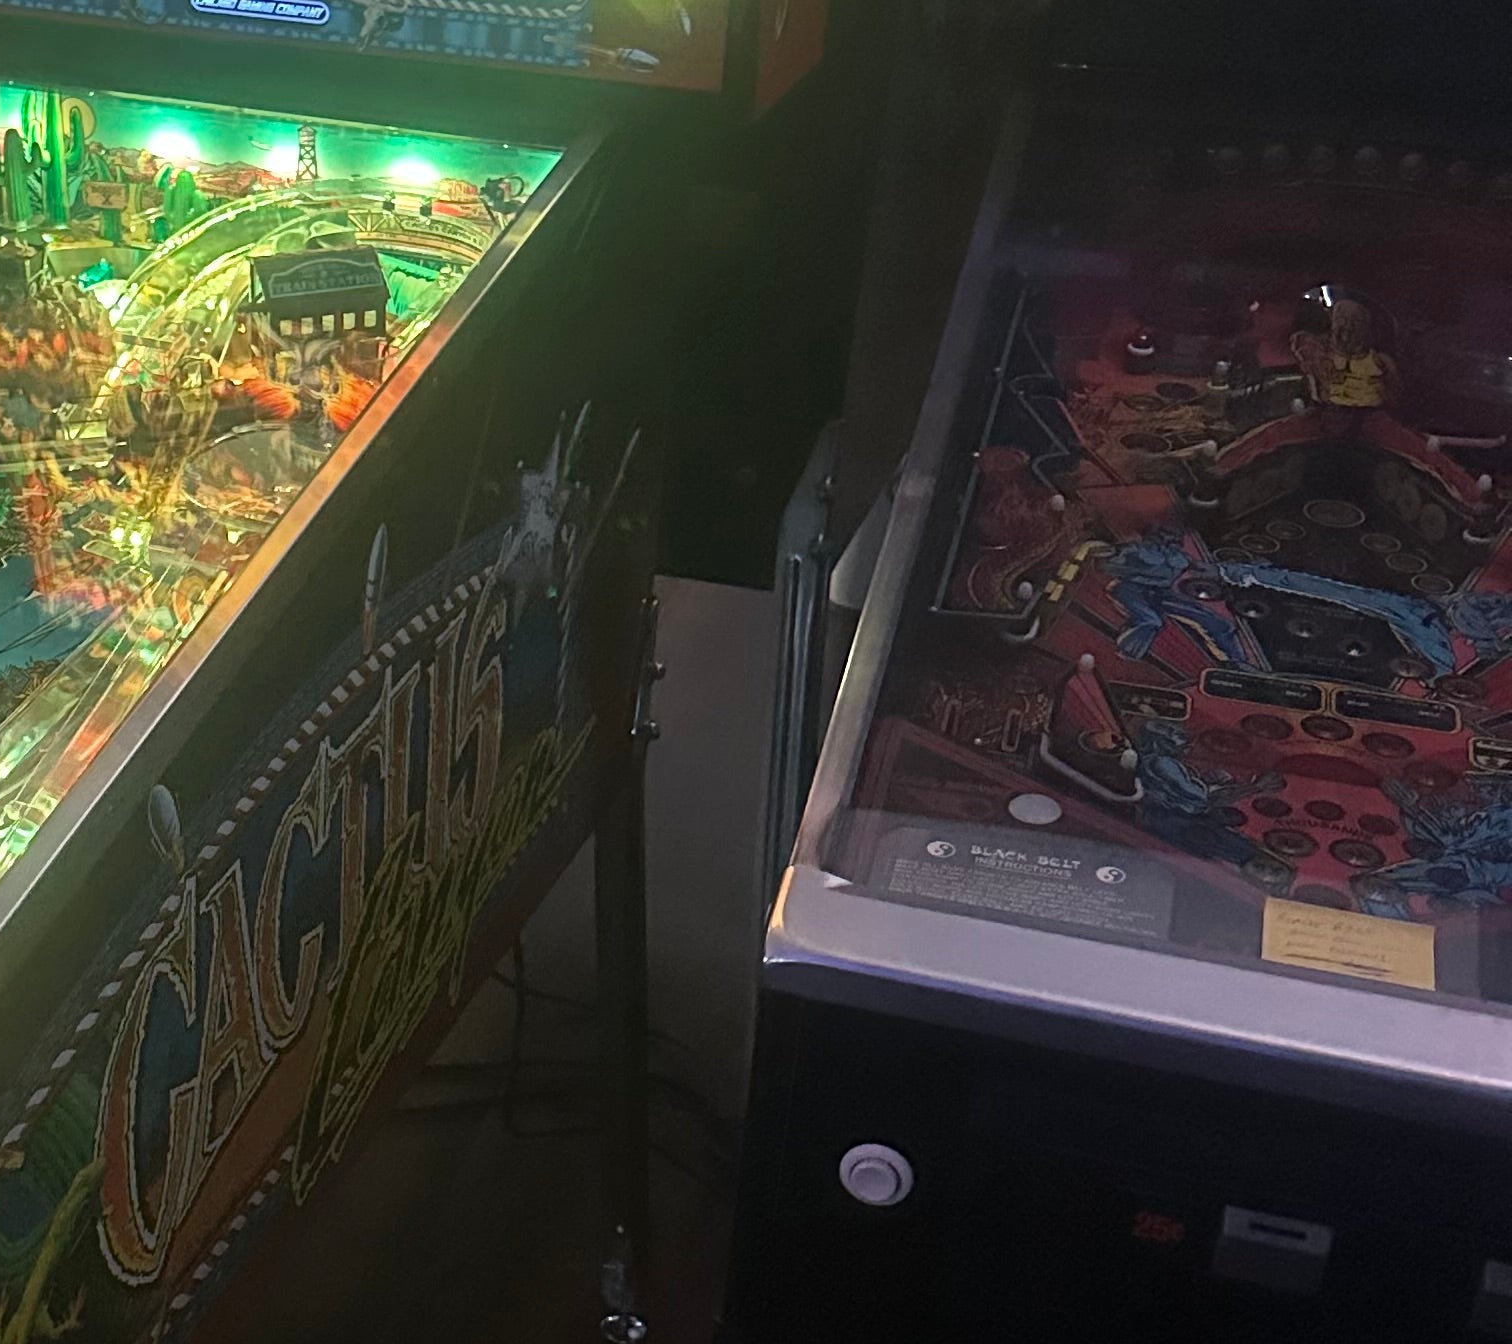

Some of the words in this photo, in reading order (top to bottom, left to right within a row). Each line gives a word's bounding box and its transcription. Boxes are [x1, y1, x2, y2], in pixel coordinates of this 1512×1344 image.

[969, 843, 1028, 863] BLACK
[1036, 853, 1082, 870] BELT
[973, 856, 1074, 878] INSTRUCTIONS
[97, 568, 505, 1286] CACTUS
